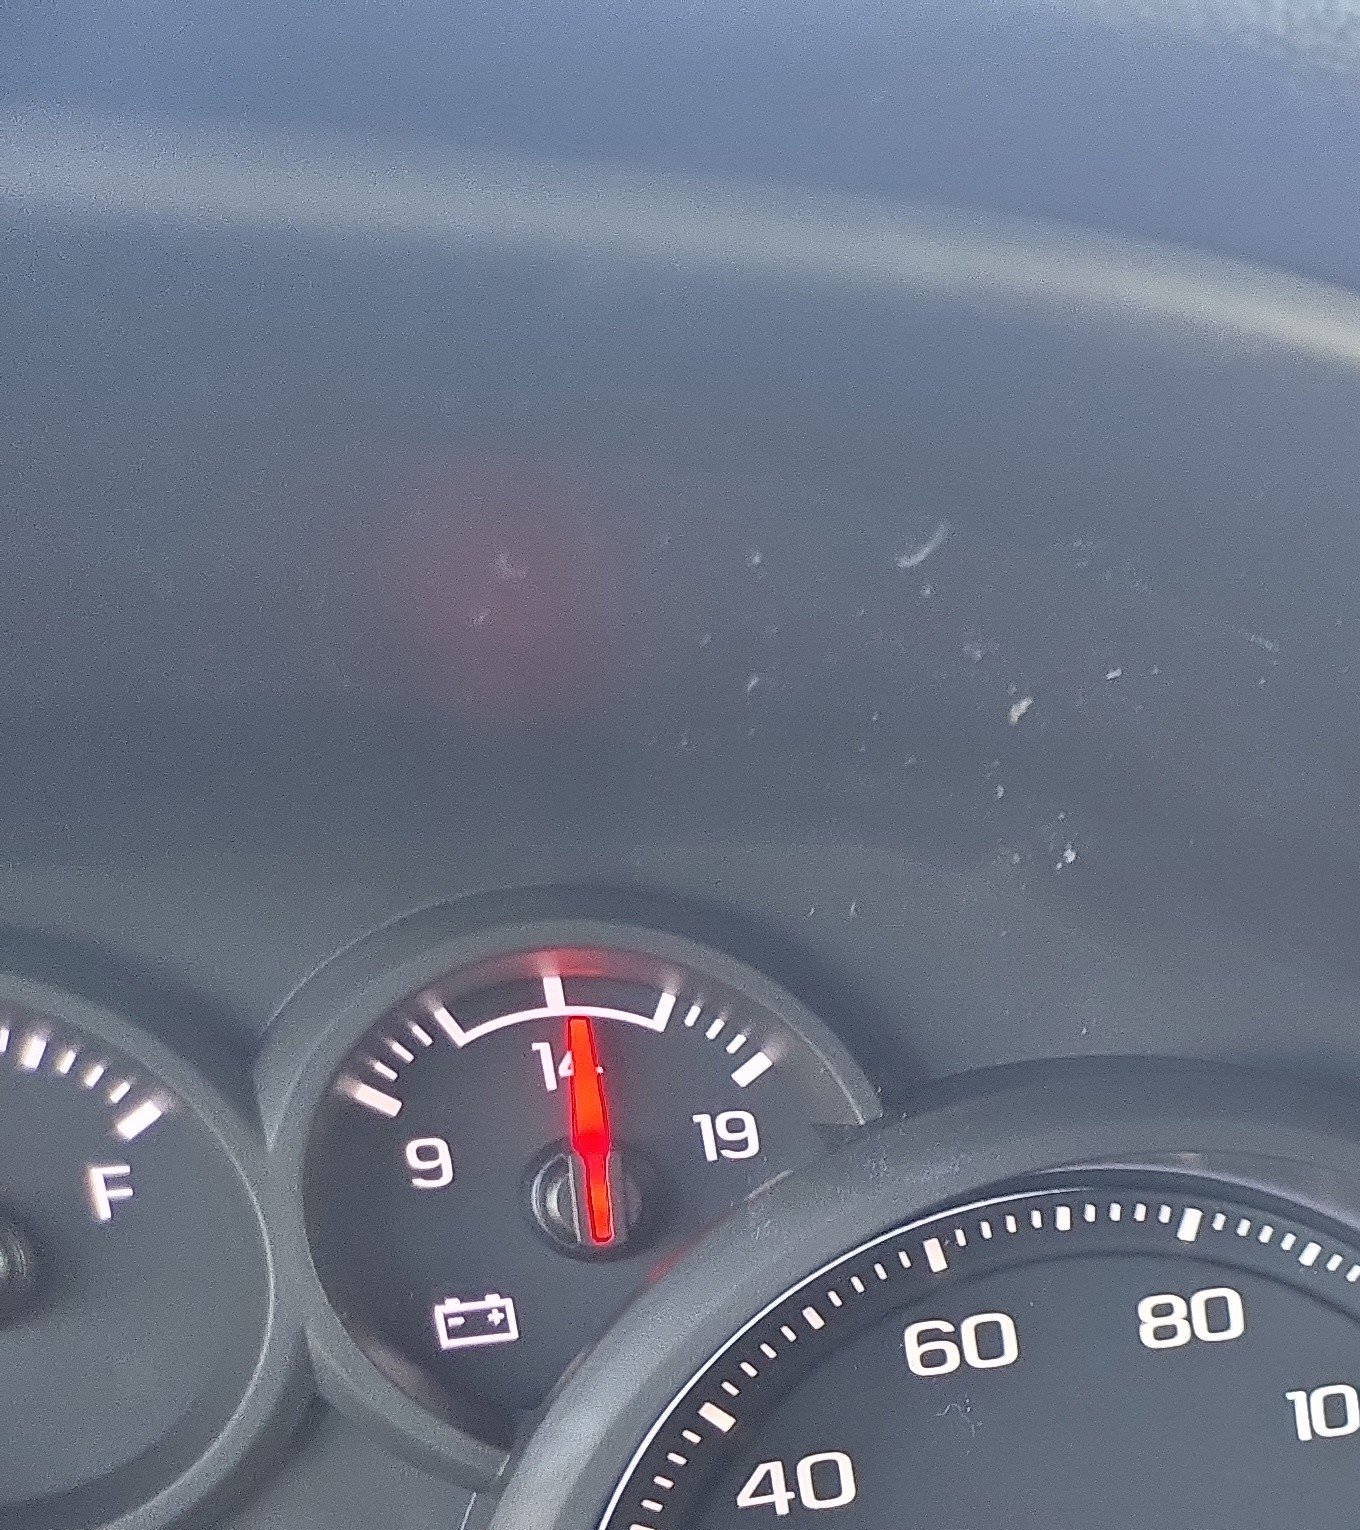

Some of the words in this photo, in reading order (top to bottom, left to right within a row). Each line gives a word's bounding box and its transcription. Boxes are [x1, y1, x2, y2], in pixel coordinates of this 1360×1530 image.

[405, 1137, 454, 1189] 9
[692, 1110, 760, 1162] 19
[87, 1164, 134, 1223] F
[903, 1312, 1019, 1377] 60
[1137, 1287, 1245, 1349] 80
[736, 1451, 857, 1517] 40
